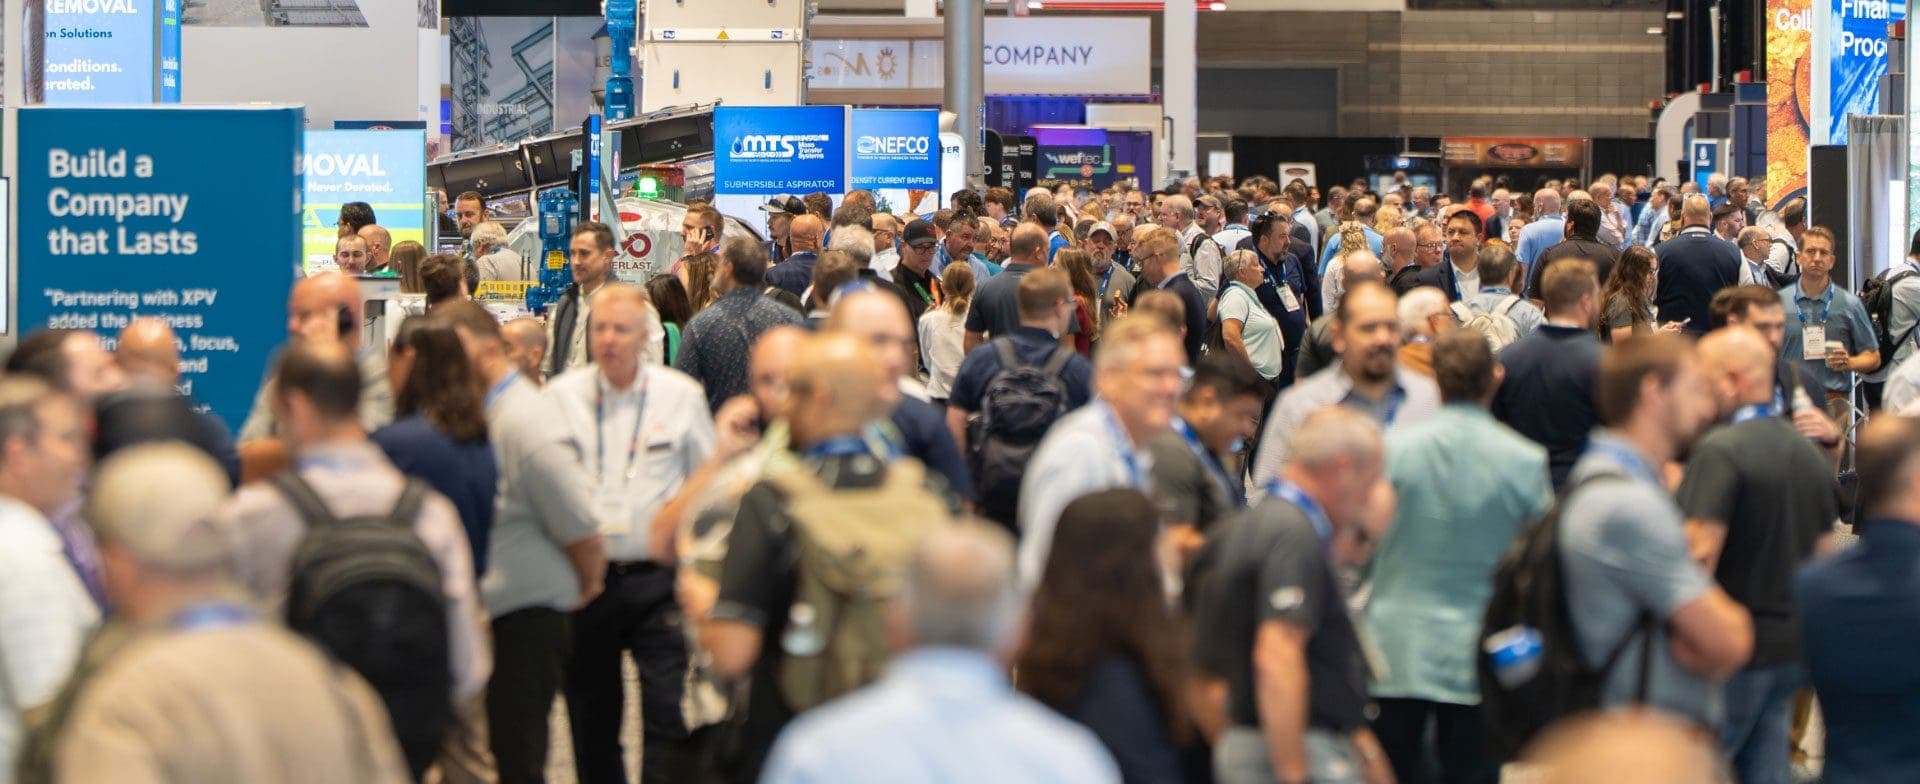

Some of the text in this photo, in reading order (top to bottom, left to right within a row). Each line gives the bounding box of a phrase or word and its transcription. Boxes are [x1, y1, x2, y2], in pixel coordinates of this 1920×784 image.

[60, 28, 113, 39] Solutions
[984, 45, 1093, 66] COMPANY
[46, 58, 122, 73] onditions.
[477, 103, 528, 115] INDUSTRIAL
[875, 136, 929, 154] NEFCO
[48, 148, 154, 178] Build a
[307, 182, 341, 192] Never
[724, 180, 835, 189] SUBMERSIBLE ASPIRATOR
[48, 186, 189, 223] Company
[47, 226, 199, 255] that Lasts
[609, 262, 652, 271] ERLAST
[142, 289, 178, 306] with
[181, 288, 218, 307] XPV
[49, 311, 98, 331] added
[101, 311, 127, 330] the
[190, 332, 240, 352] focus,
